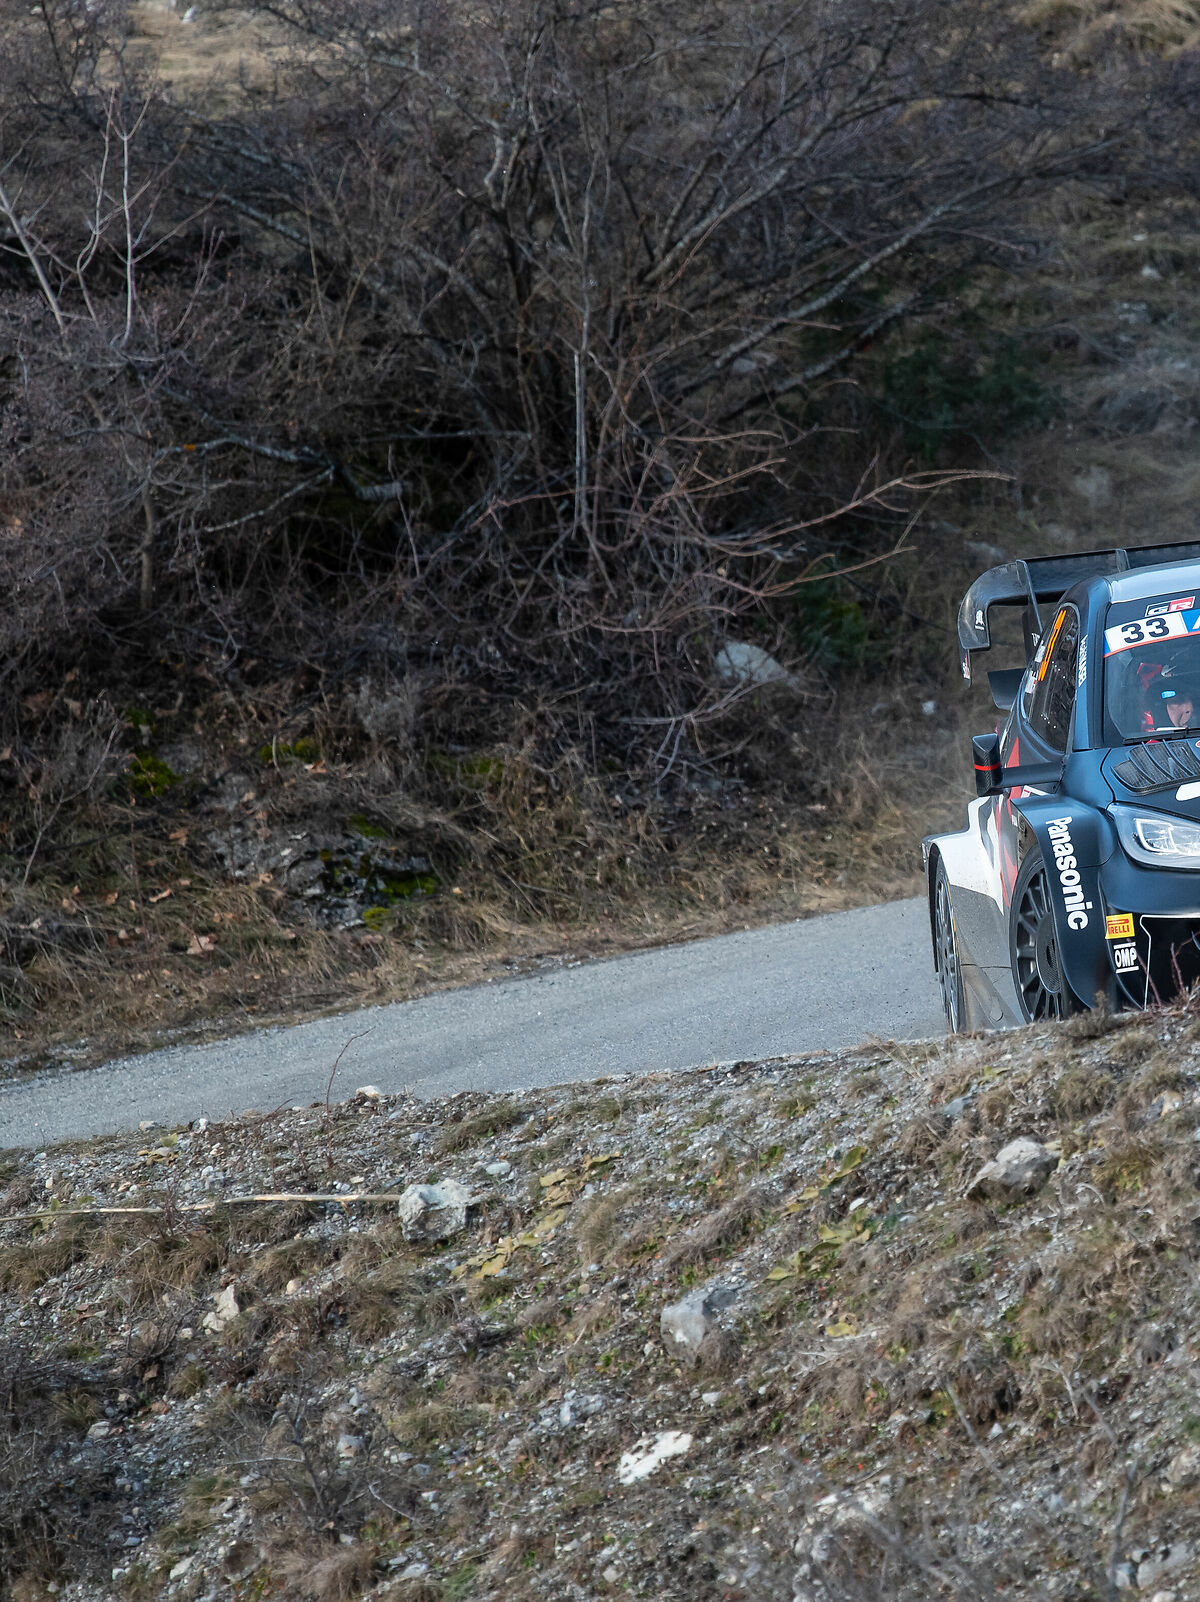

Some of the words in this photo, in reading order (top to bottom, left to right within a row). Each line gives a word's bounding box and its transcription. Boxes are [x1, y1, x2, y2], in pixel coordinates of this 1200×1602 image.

[1121, 617, 1170, 644] 33
[1045, 816, 1094, 931] Panasonic
[1114, 947, 1137, 968] OMP
